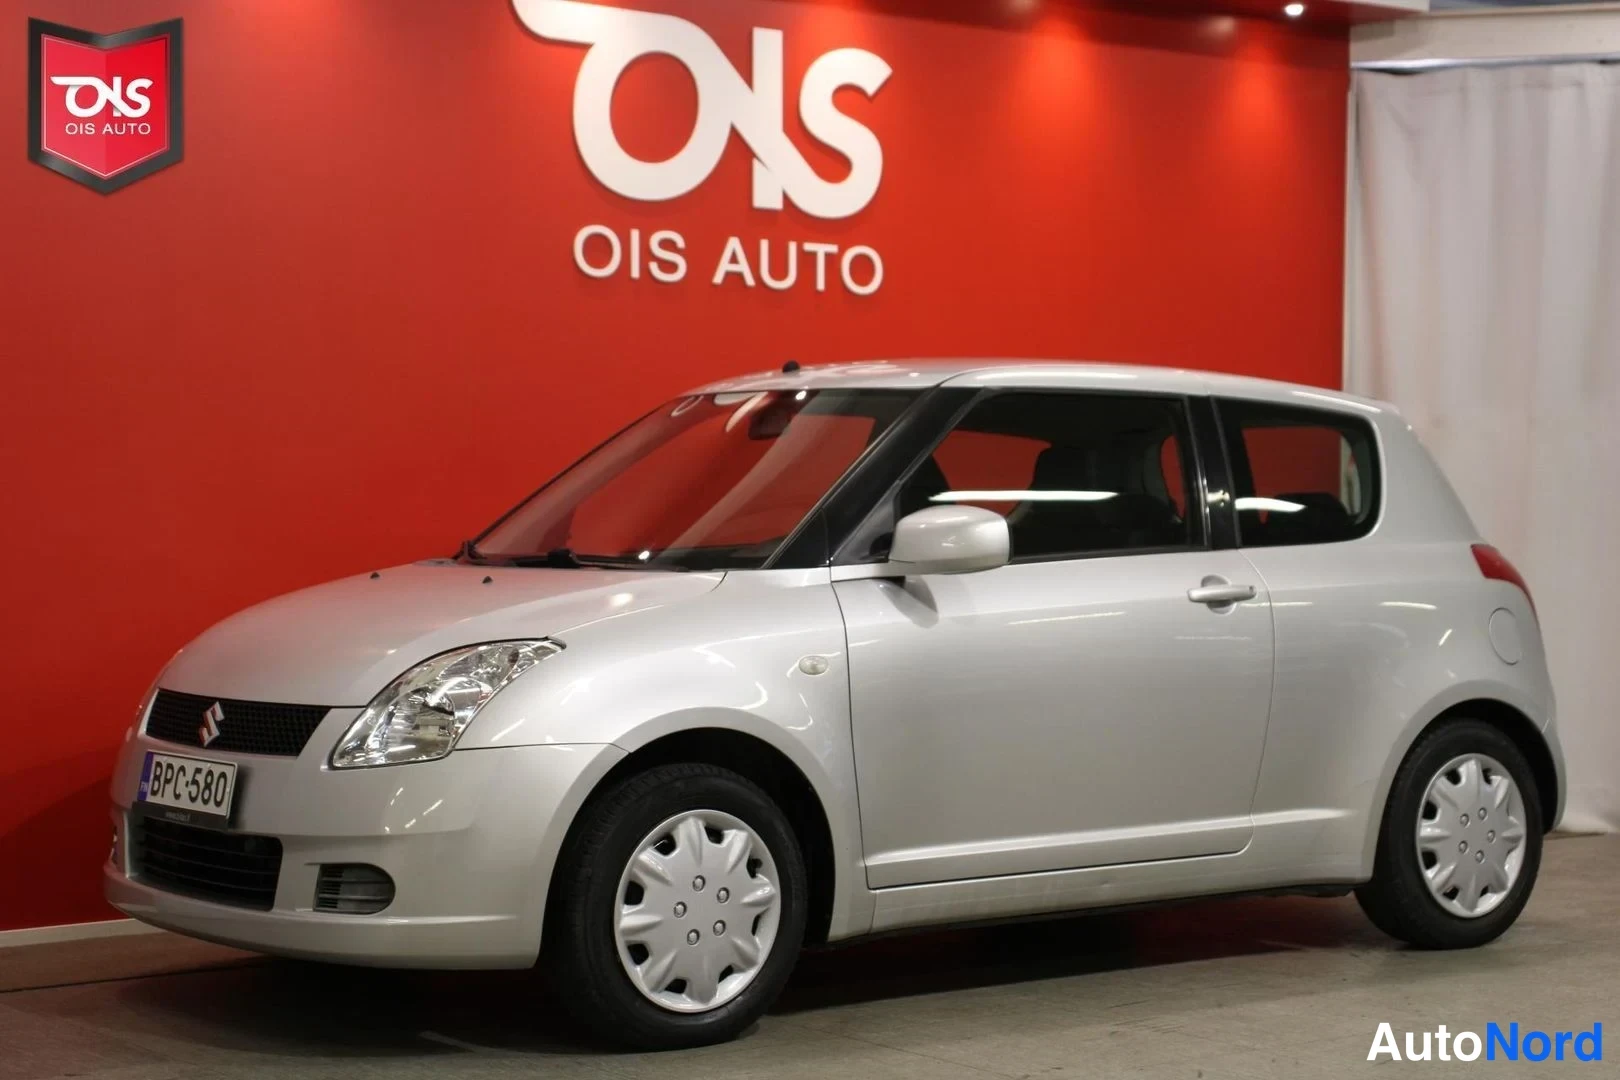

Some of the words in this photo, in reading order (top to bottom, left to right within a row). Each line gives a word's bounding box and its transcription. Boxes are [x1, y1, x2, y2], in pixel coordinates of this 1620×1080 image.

[513, 0, 893, 219] OIS
[573, 225, 688, 283] OIS
[712, 236, 884, 296] AUTO
